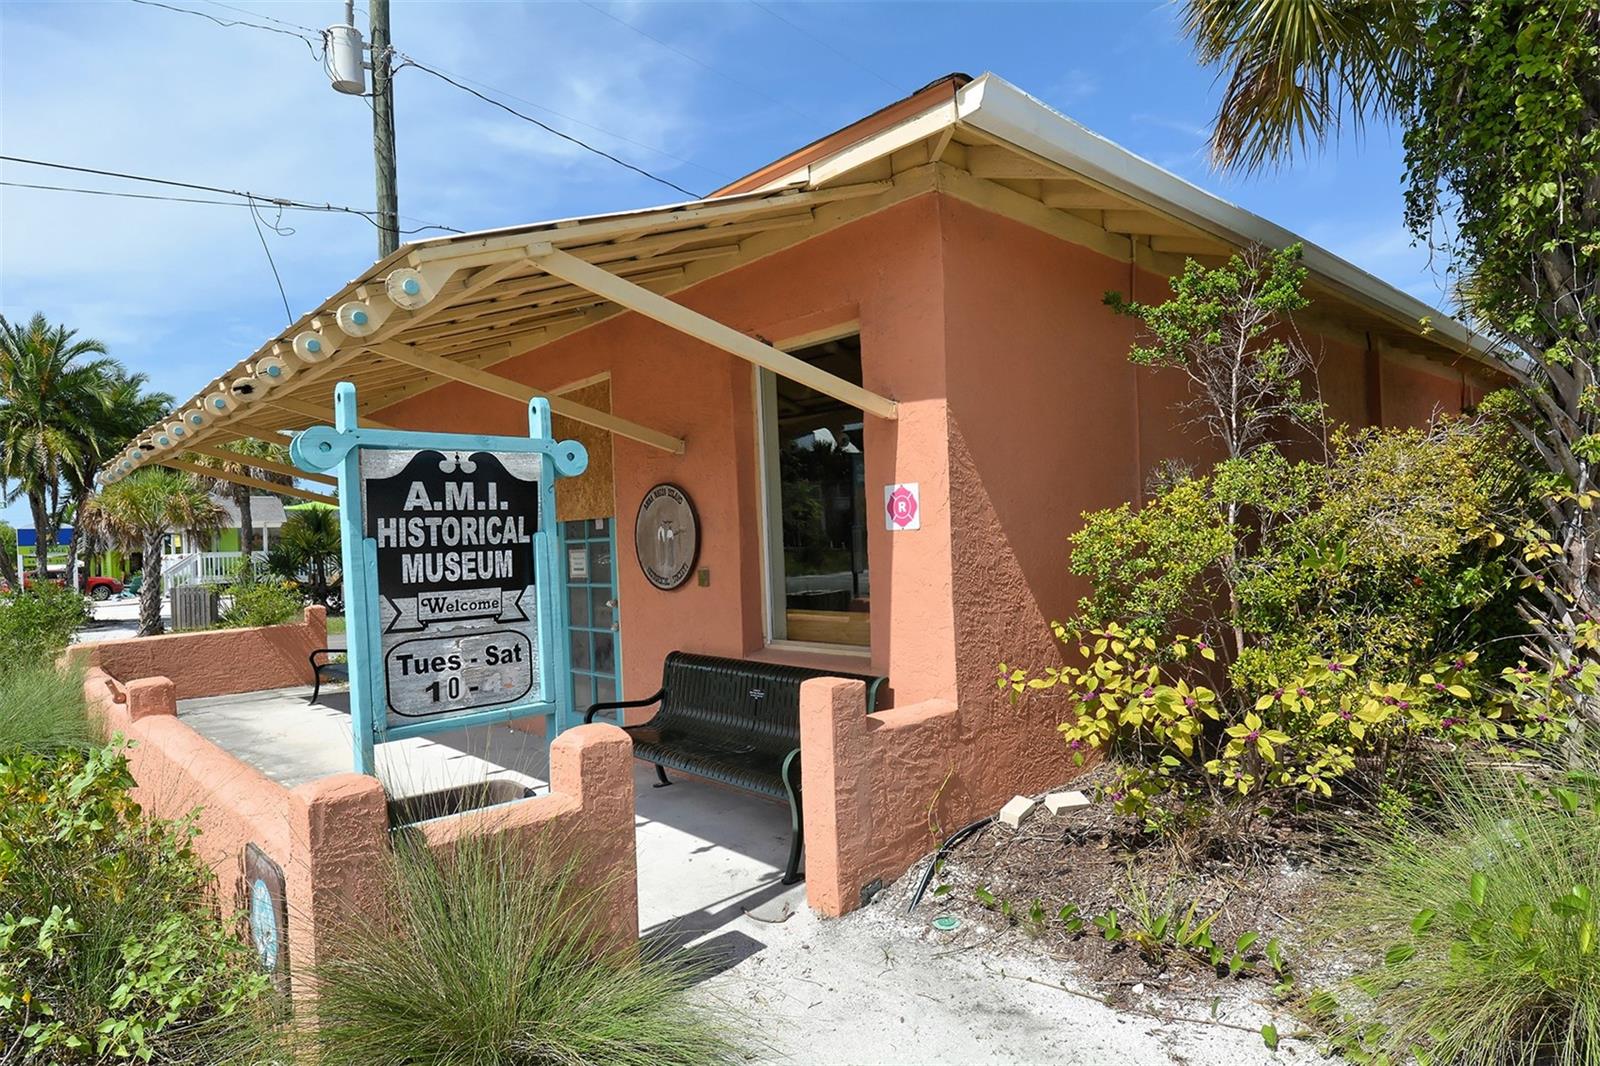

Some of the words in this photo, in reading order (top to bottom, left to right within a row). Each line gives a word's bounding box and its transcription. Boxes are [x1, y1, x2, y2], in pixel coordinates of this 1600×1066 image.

[403, 481, 509, 511] A.M.I.
[898, 502, 906, 512] R
[377, 515, 530, 548] HISTORICAL
[402, 550, 513, 584] MUSEUM
[421, 597, 500, 614] Welcome
[396, 654, 462, 675] Tues
[485, 643, 522, 666] Sat
